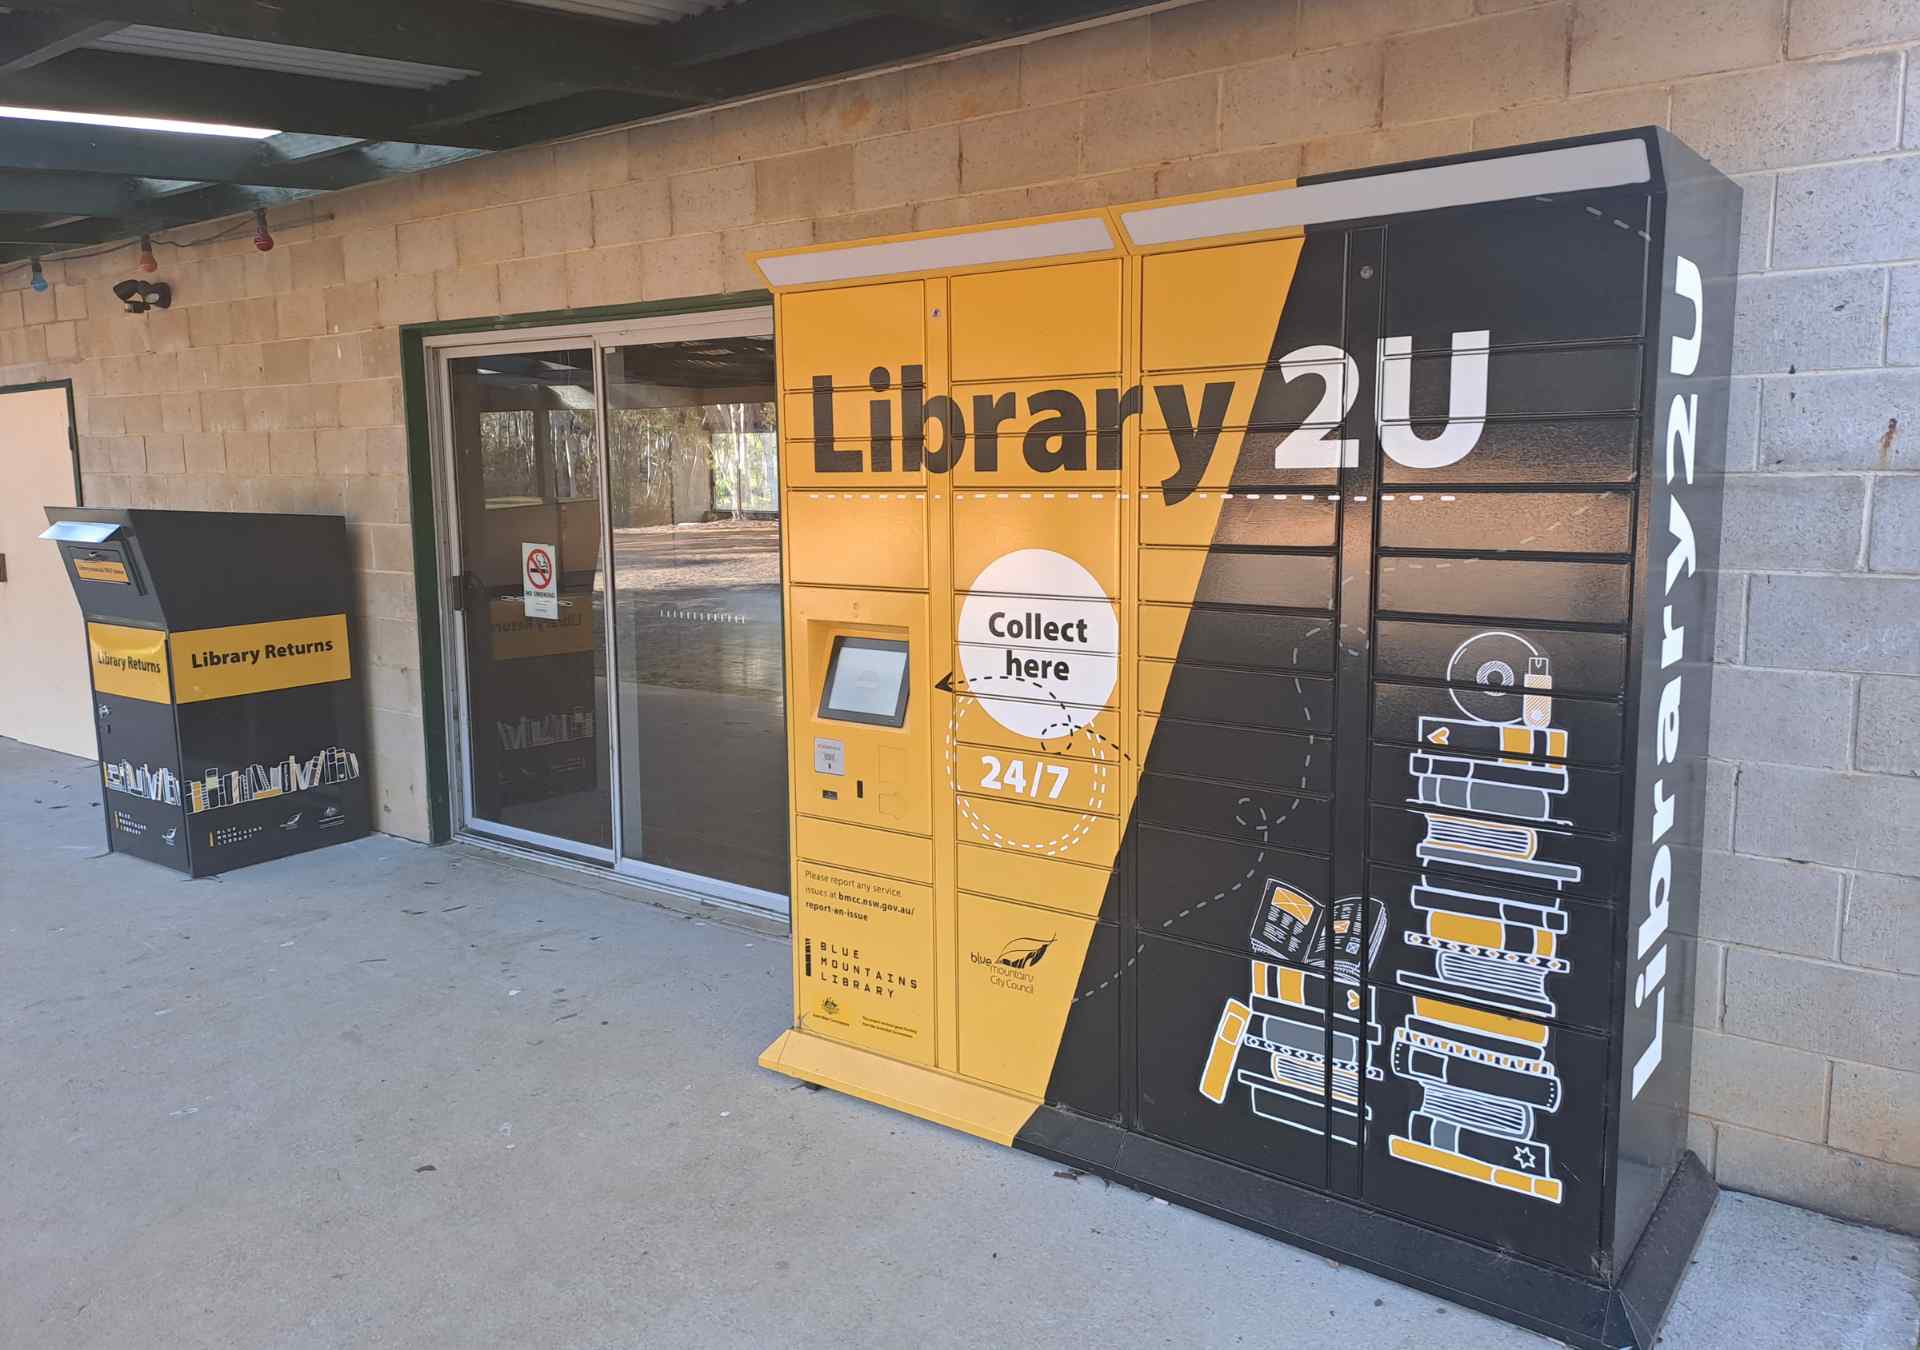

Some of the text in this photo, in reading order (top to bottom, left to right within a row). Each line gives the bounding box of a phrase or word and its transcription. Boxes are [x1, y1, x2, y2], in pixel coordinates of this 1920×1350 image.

[811, 329, 1490, 507] Library 2U
[988, 611, 1088, 644] Collect
[97, 651, 161, 674] Library Returns
[191, 640, 334, 669] Library Returns
[1005, 650, 1070, 681] here
[980, 755, 1069, 800] 24/7
[805, 870, 829, 882] Please
[830, 876, 856, 888] report
[857, 882, 871, 893] any
[805, 887, 915, 916] issues at bmcc.nsw.gov.au/
[805, 901, 869, 921] report-an-issue
[820, 942, 860, 960] BLUE
[970, 951, 992, 967] blue
[820, 957, 918, 989] MOUNTAINS
[820, 972, 895, 998] LIBRARY
[1006, 980, 1034, 995] Council
